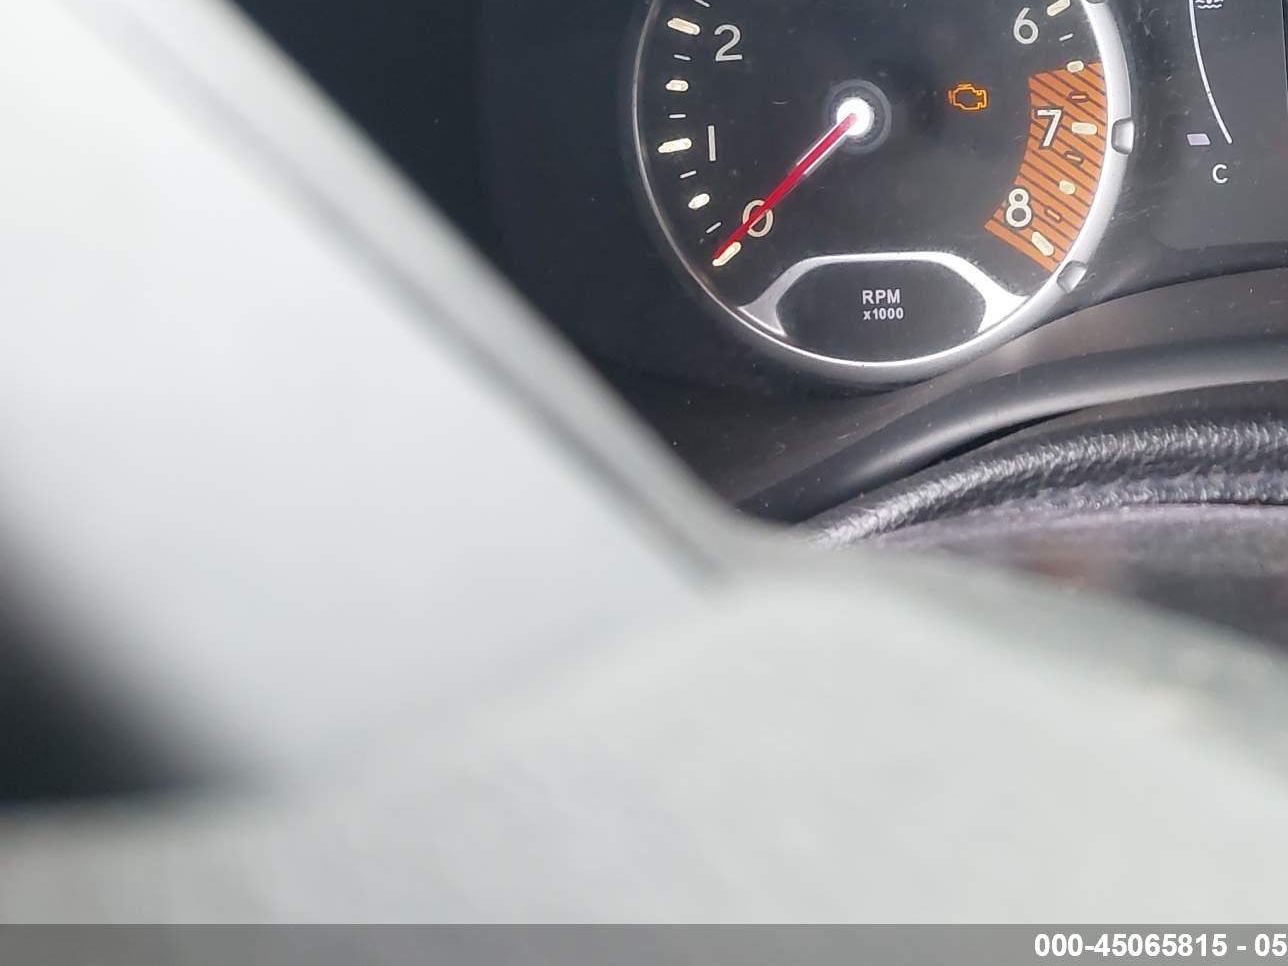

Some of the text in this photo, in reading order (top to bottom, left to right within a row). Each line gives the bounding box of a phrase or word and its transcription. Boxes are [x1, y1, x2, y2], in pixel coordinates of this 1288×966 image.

[715, 25, 742, 61] 2
[1014, 8, 1038, 44] 6
[708, 126, 716, 161] 1
[1035, 108, 1064, 148] 7
[1213, 164, 1227, 183] C
[741, 199, 774, 237] 0
[1004, 187, 1034, 229] 8
[863, 289, 900, 305] RPM
[864, 308, 903, 320] x1000
